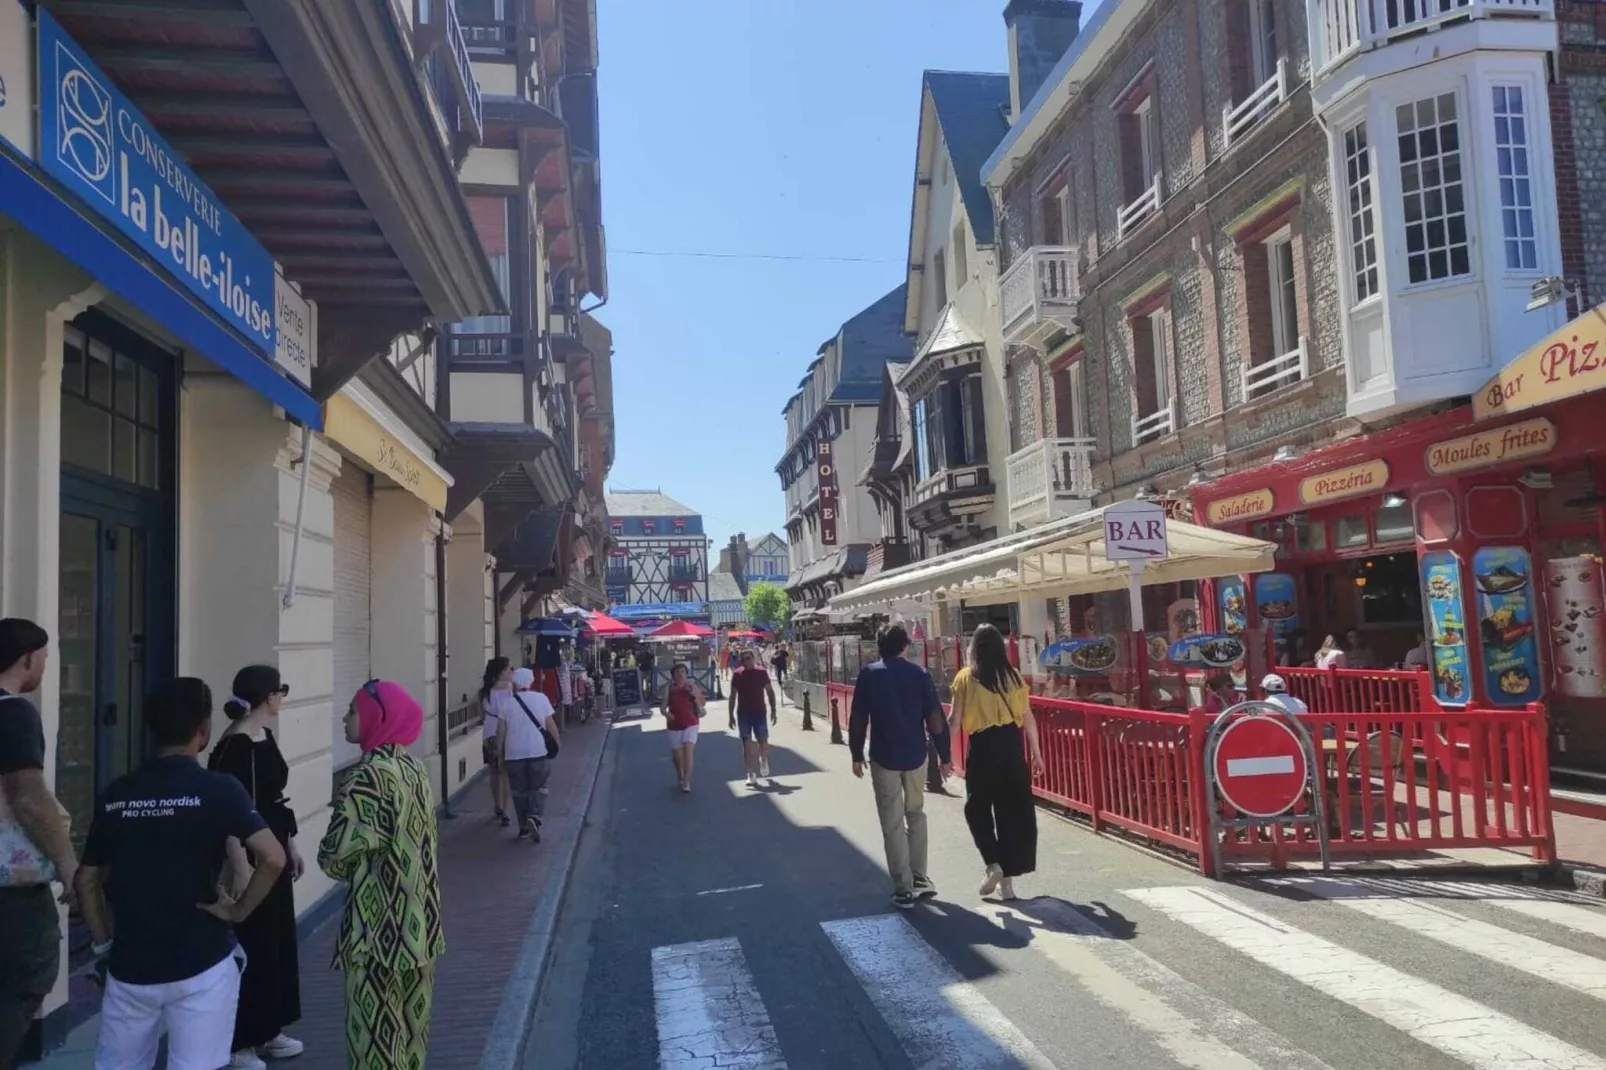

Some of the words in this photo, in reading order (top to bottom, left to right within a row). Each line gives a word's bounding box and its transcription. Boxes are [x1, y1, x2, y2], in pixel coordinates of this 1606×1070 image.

[118, 108, 222, 237] CONSERVERIE
[120, 150, 148, 233] la
[153, 183, 272, 340] belle-iloise
[277, 289, 304, 337] Vente
[1486, 373, 1524, 408] Bar
[1540, 334, 1606, 384] Piz
[1432, 437, 1491, 468] Moules
[1497, 427, 1549, 459] frites
[818, 443, 834, 541] HOTEL
[1315, 469, 1374, 496] Pizzéria
[1218, 496, 1265, 520] Saladerie
[1107, 519, 1164, 542] BAR
[121, 809, 140, 819] PRO
[140, 808, 175, 817] CYCLING
[128, 799, 157, 809] novo
[159, 795, 201, 808] nordisk
